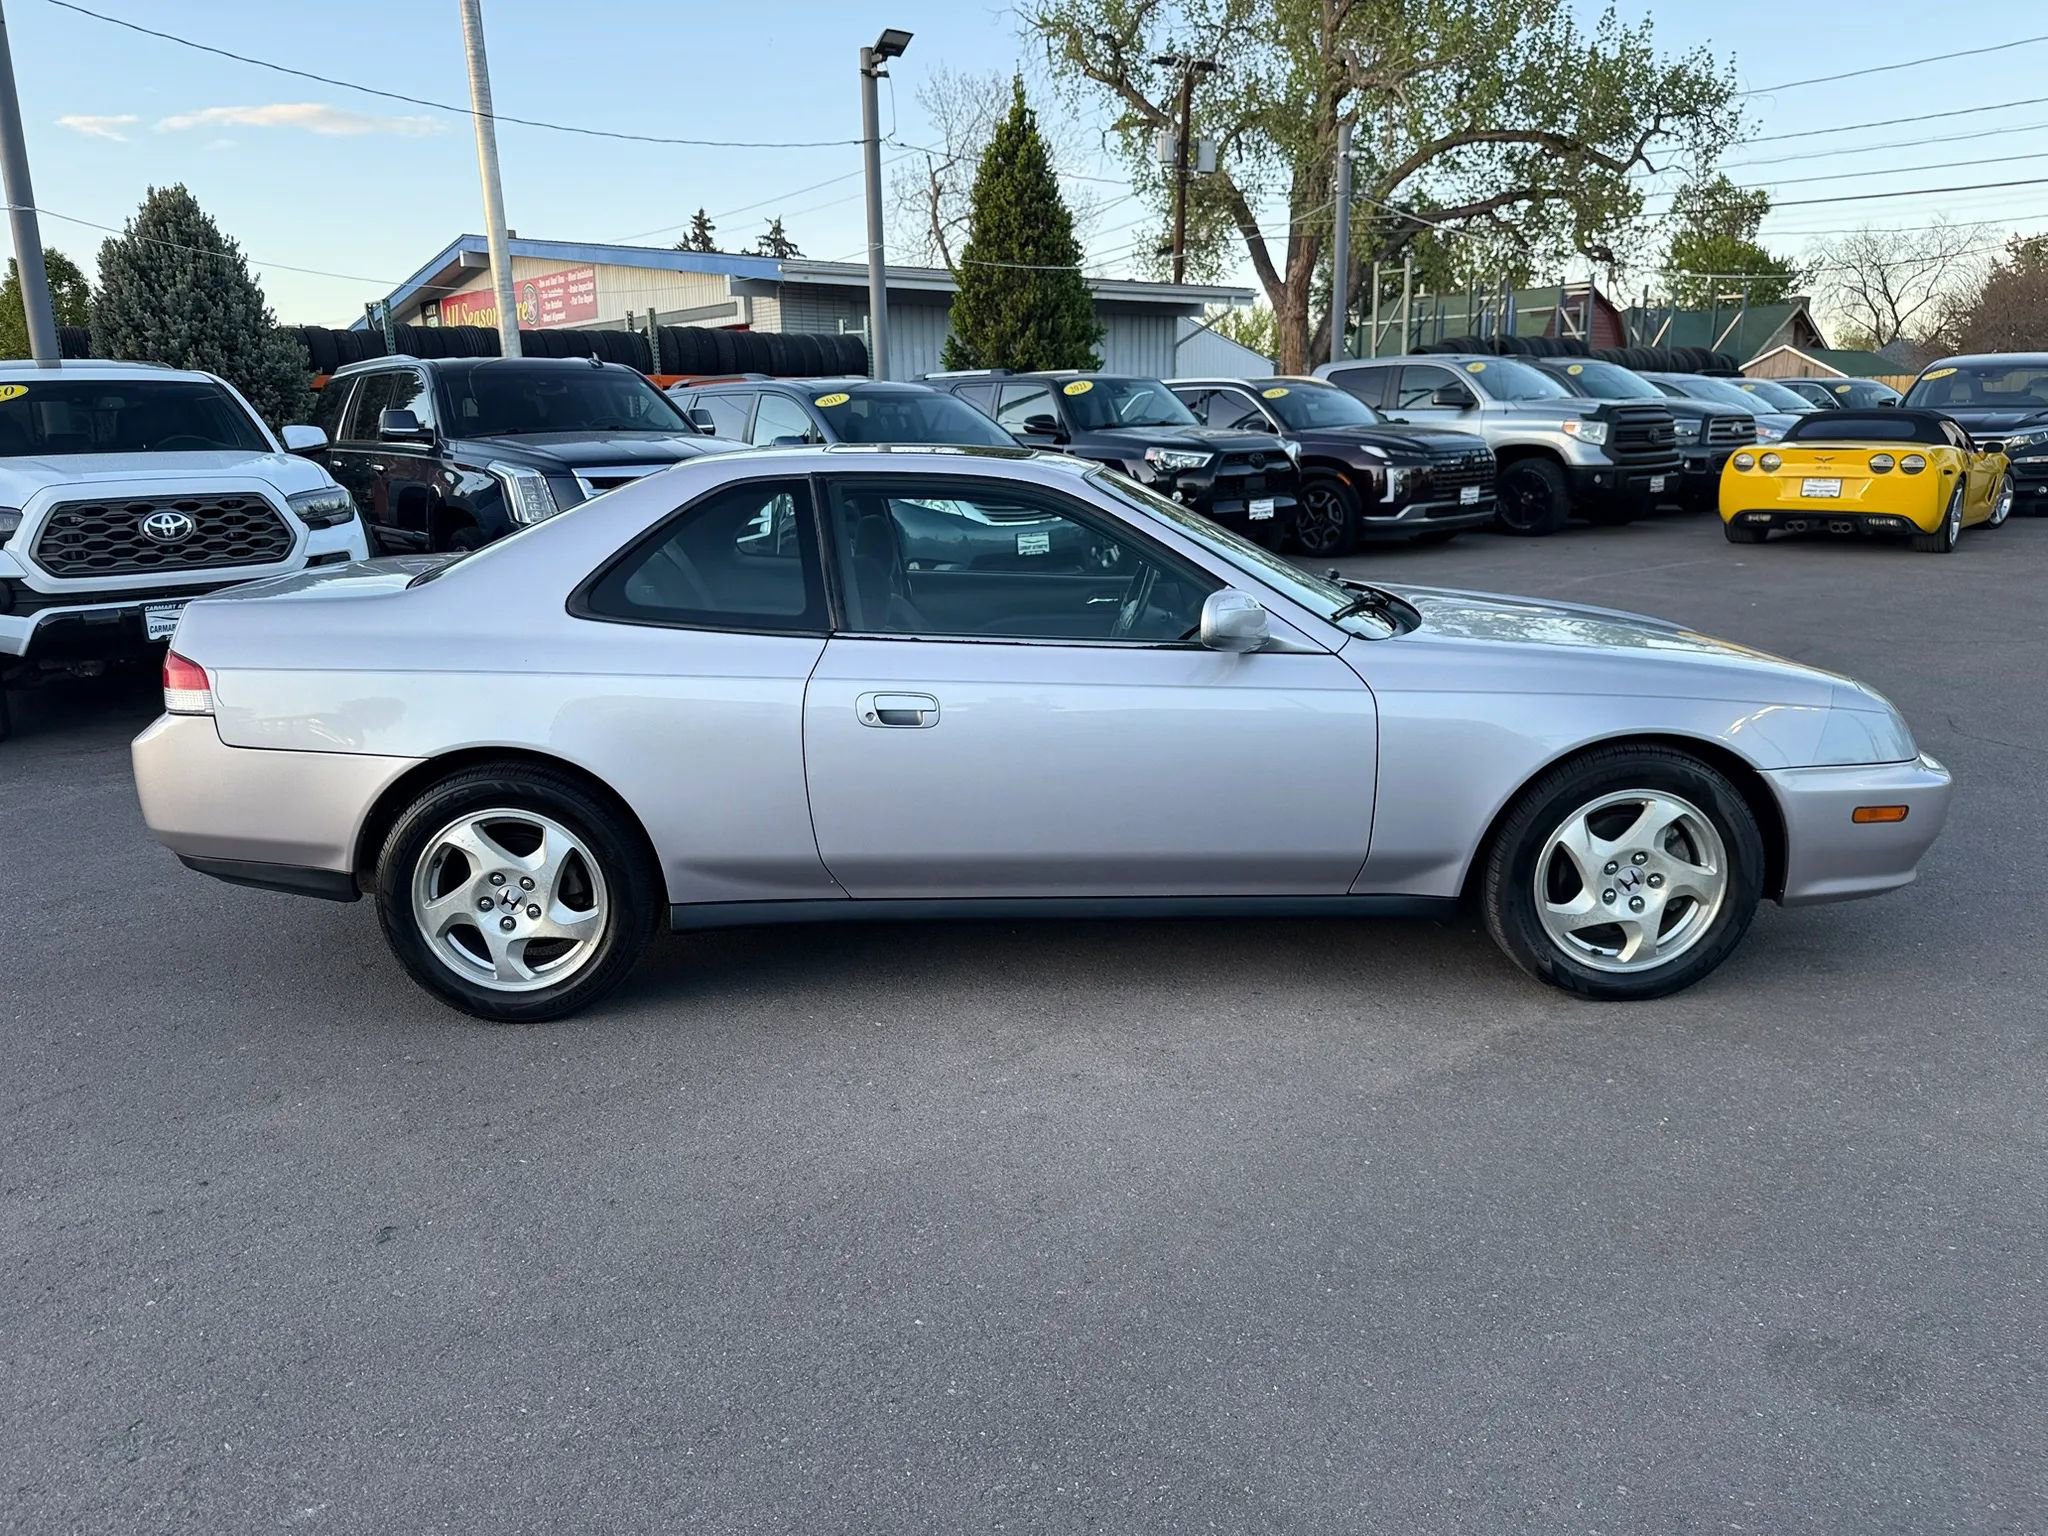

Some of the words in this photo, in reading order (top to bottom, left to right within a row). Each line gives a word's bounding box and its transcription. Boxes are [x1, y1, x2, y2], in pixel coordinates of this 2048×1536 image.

[445, 303, 459, 326] All
[821, 395, 842, 405] 2017
[144, 604, 176, 612] CARMART
